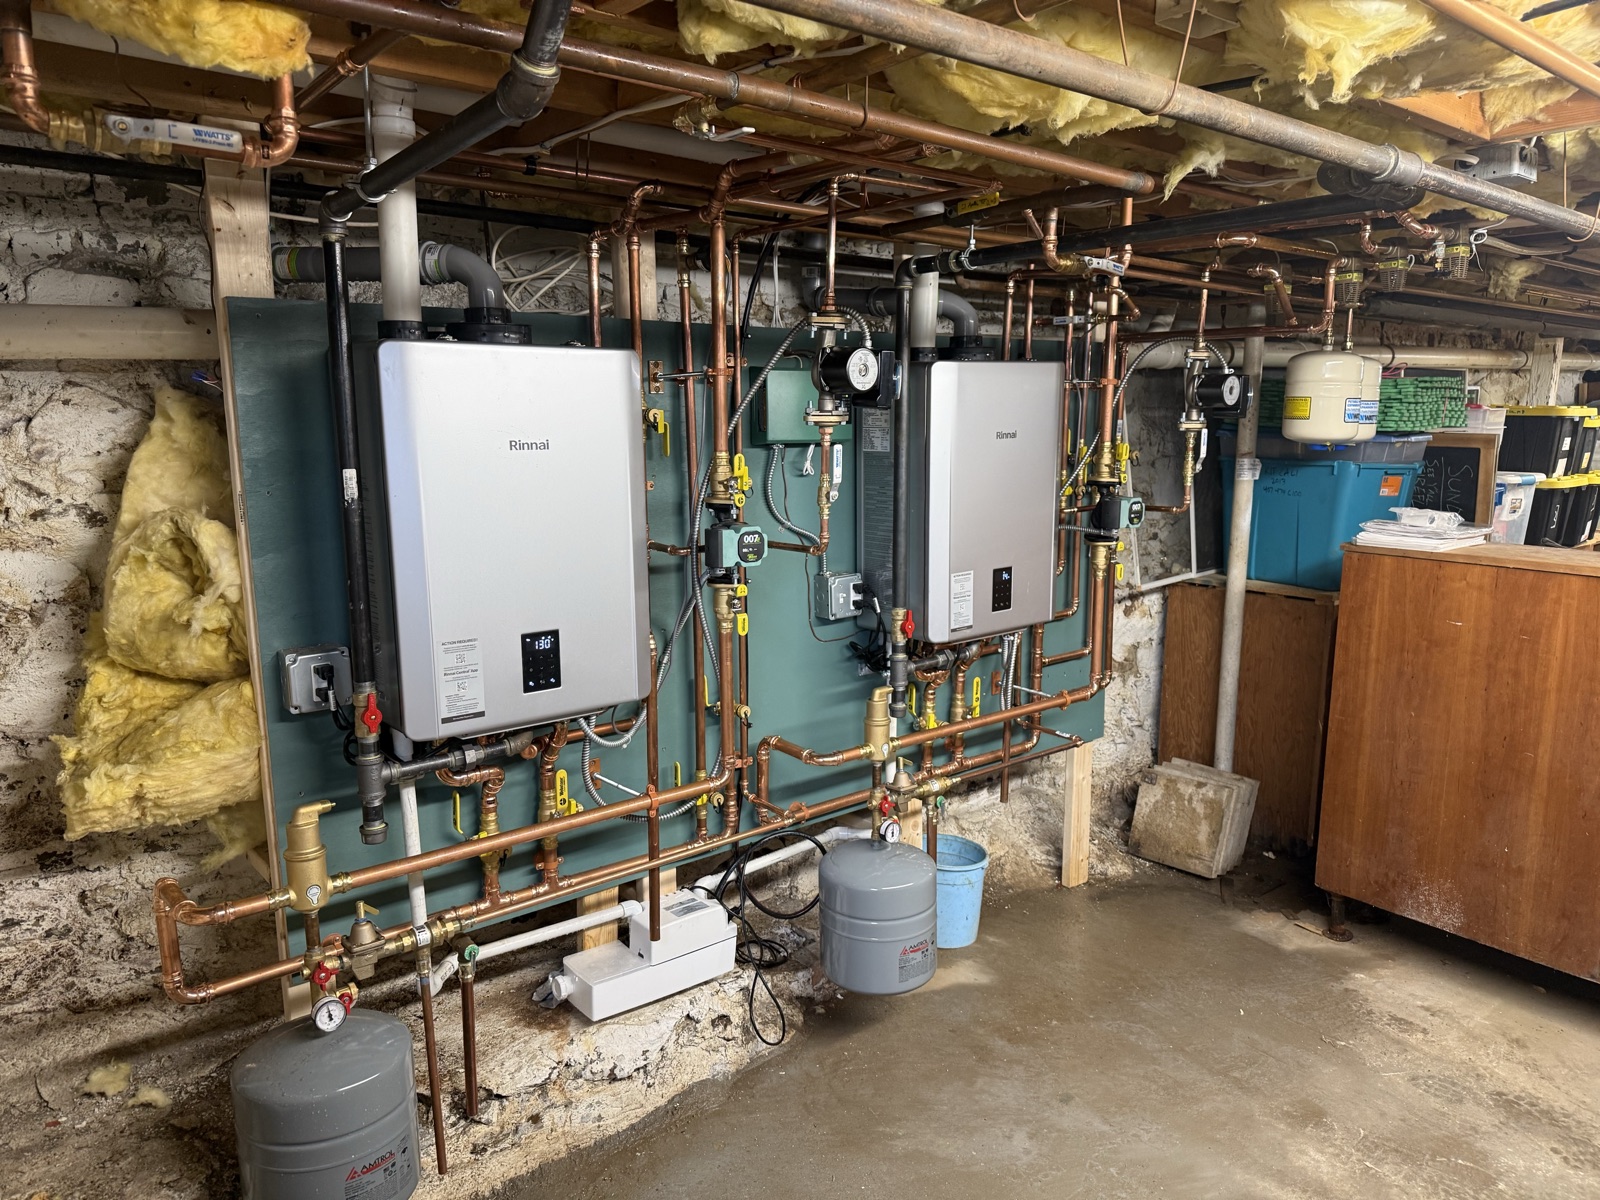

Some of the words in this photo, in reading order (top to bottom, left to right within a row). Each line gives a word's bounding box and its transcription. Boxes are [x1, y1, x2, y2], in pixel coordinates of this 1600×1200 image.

[996, 429, 1018, 440] Rinnai
[509, 439, 550, 451] Rinnai
[1425, 459, 1440, 478] SEE
[535, 638, 551, 650] 130
[360, 1149, 394, 1173] AMTROL
